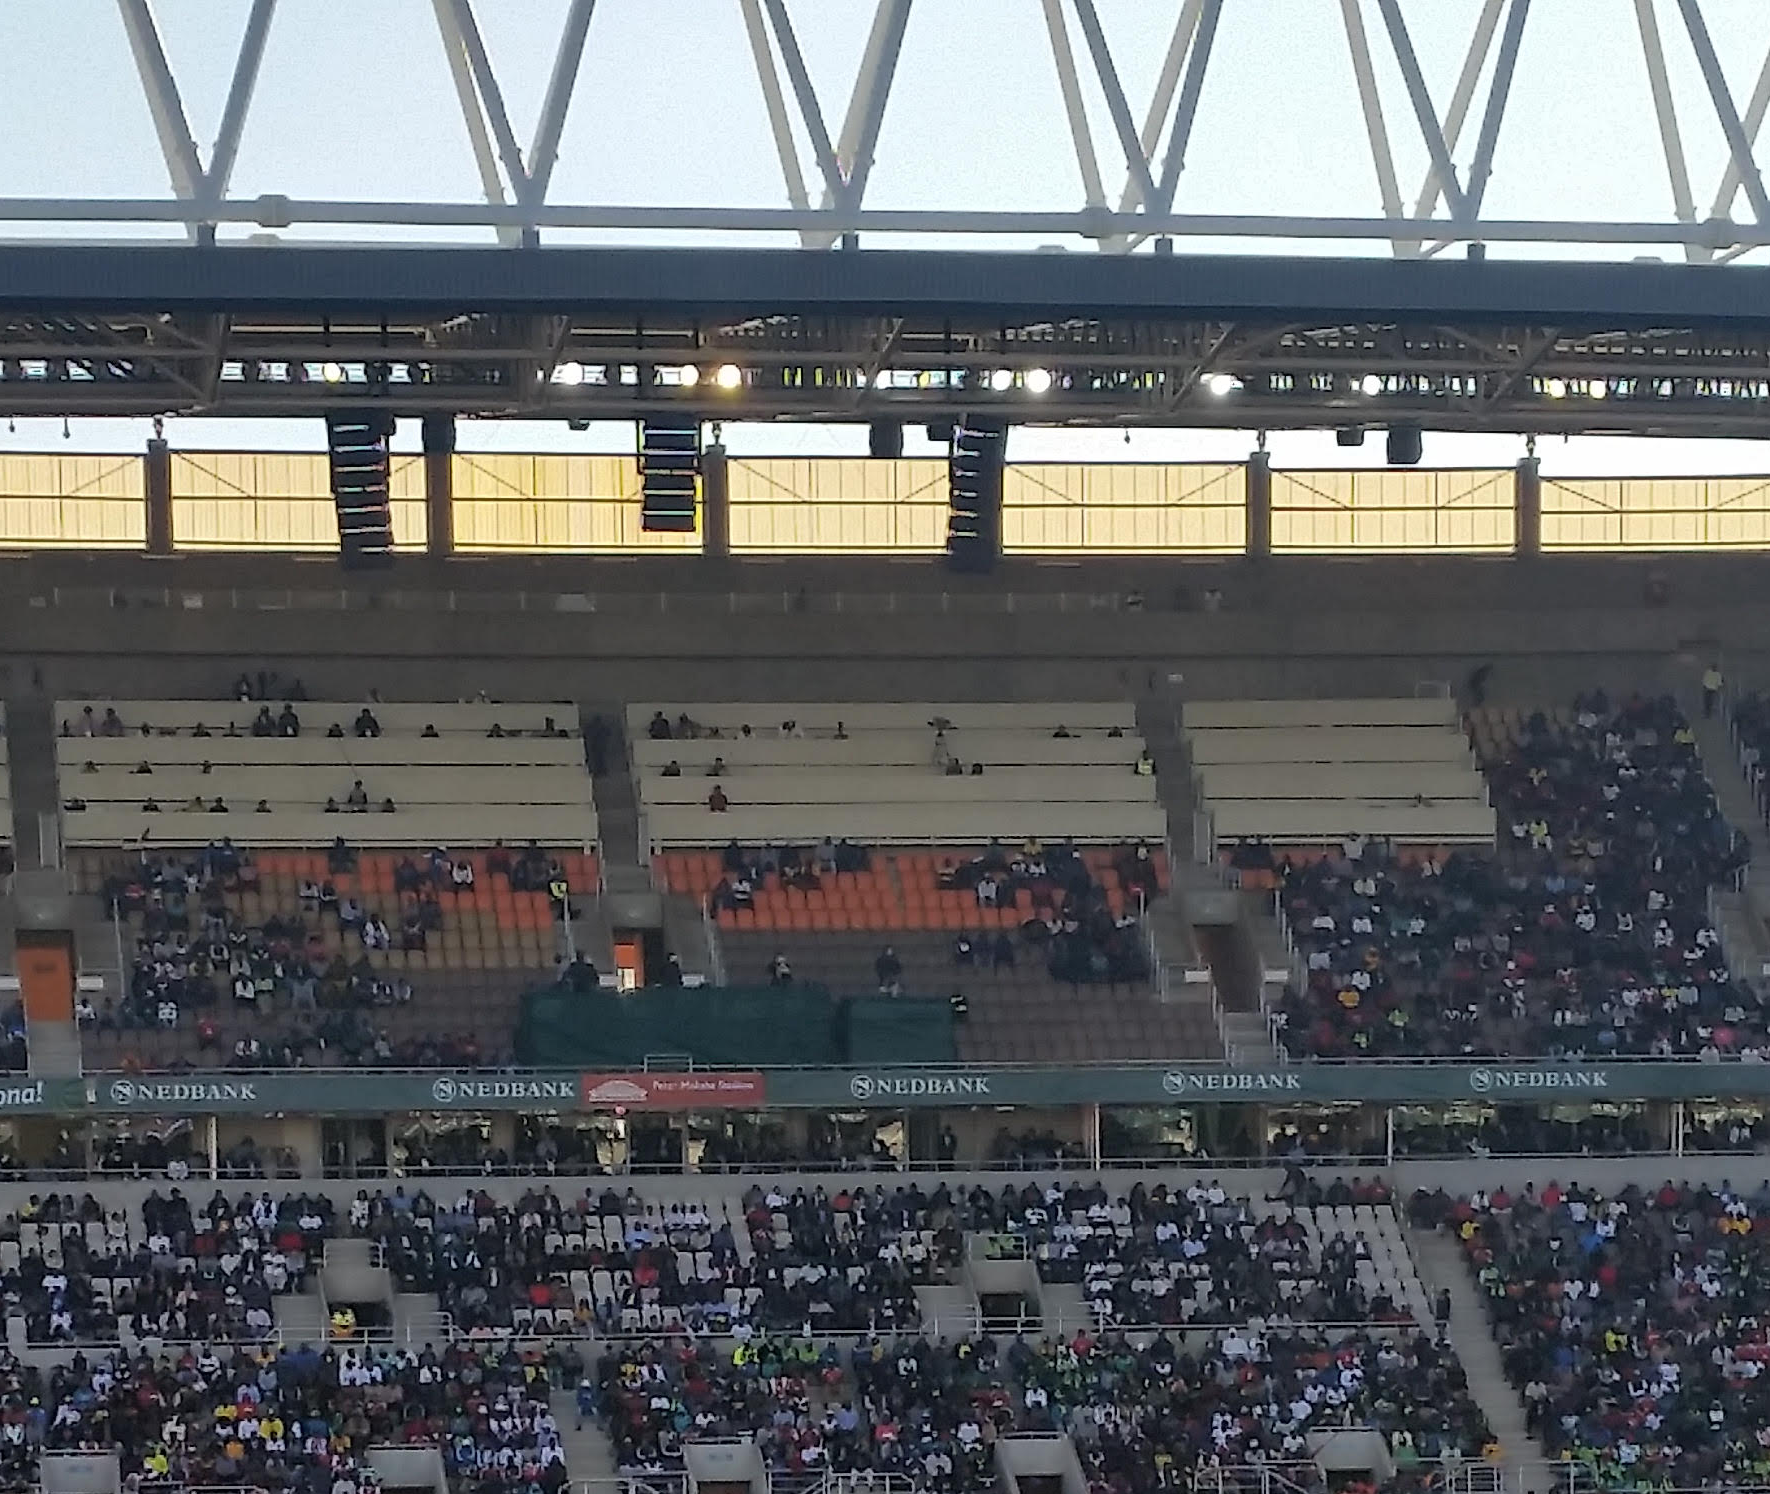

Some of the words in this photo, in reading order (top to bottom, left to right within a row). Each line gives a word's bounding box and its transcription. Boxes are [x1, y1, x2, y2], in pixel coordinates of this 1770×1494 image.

[875, 1076, 990, 1095] NEDBANK
[1188, 1071, 1300, 1090] NEDBANK
[1495, 1070, 1608, 1088] NEDBANK
[137, 1082, 256, 1102] NEDBANK
[459, 1079, 574, 1099] NEDBANK
